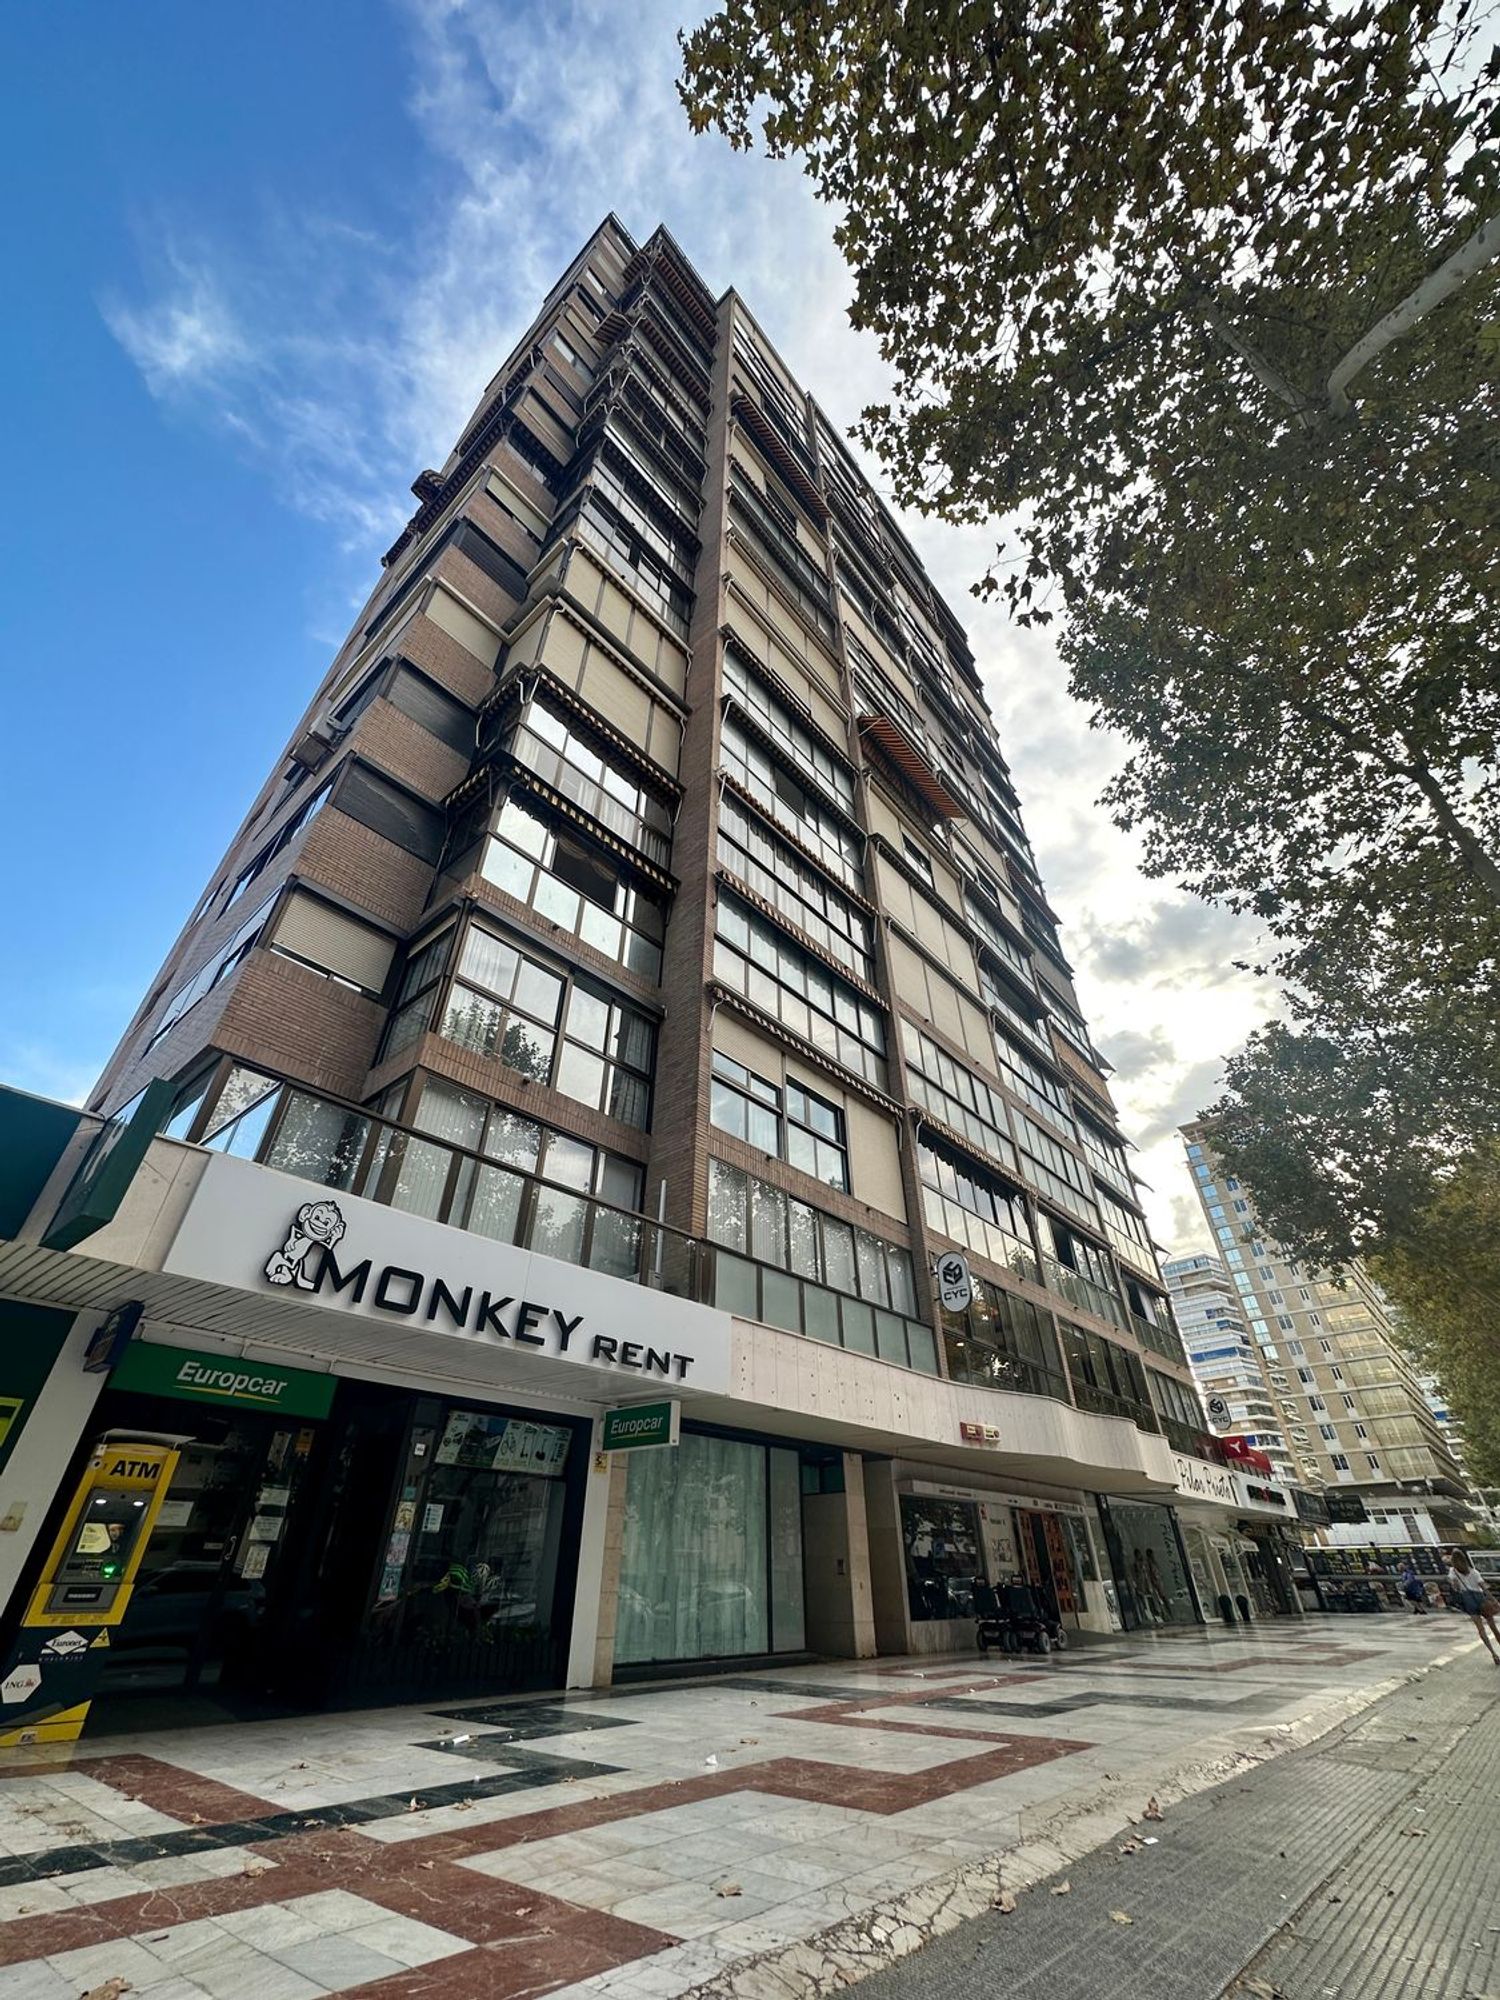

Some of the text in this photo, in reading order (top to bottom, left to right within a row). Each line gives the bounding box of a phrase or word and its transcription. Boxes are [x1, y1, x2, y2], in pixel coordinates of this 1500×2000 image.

[944, 1288, 968, 1301] CYC
[312, 1248, 694, 1379] MONKEY RENT
[176, 1360, 288, 1396] Europcar
[610, 1416, 664, 1438] Europcar
[110, 1460, 161, 1479] ATM
[5, 1681, 24, 1689] ING
